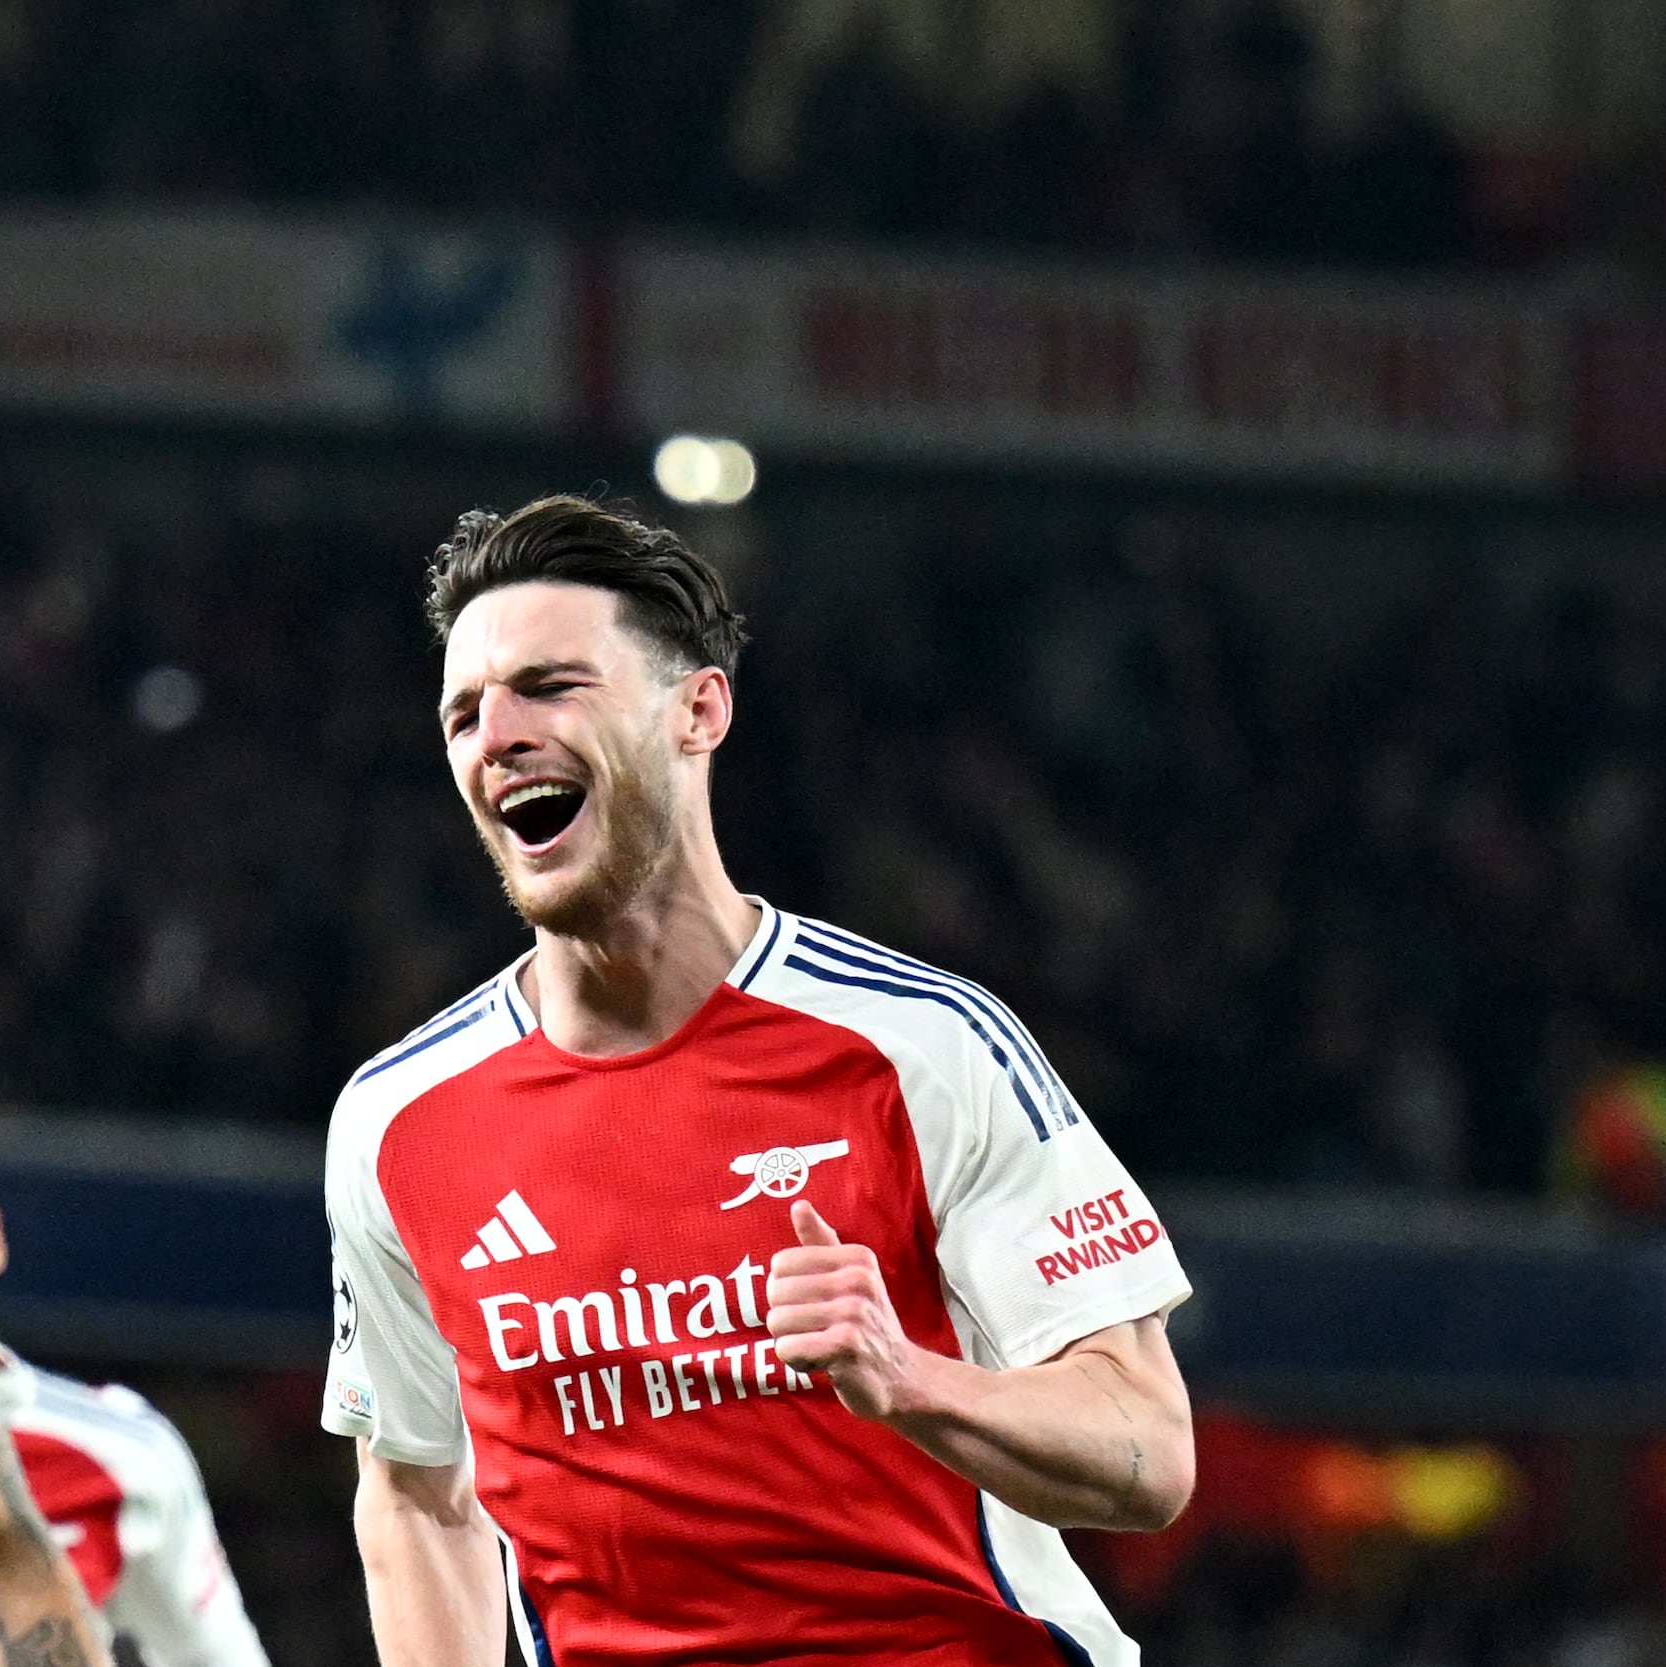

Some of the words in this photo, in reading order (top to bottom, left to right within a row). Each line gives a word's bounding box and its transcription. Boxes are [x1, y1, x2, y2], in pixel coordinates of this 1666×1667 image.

[1049, 1188, 1130, 1240] VISIT
[1035, 1218, 1167, 1287] RWAND
[477, 1253, 775, 1373] Emirat
[553, 1365, 625, 1437] FLY
